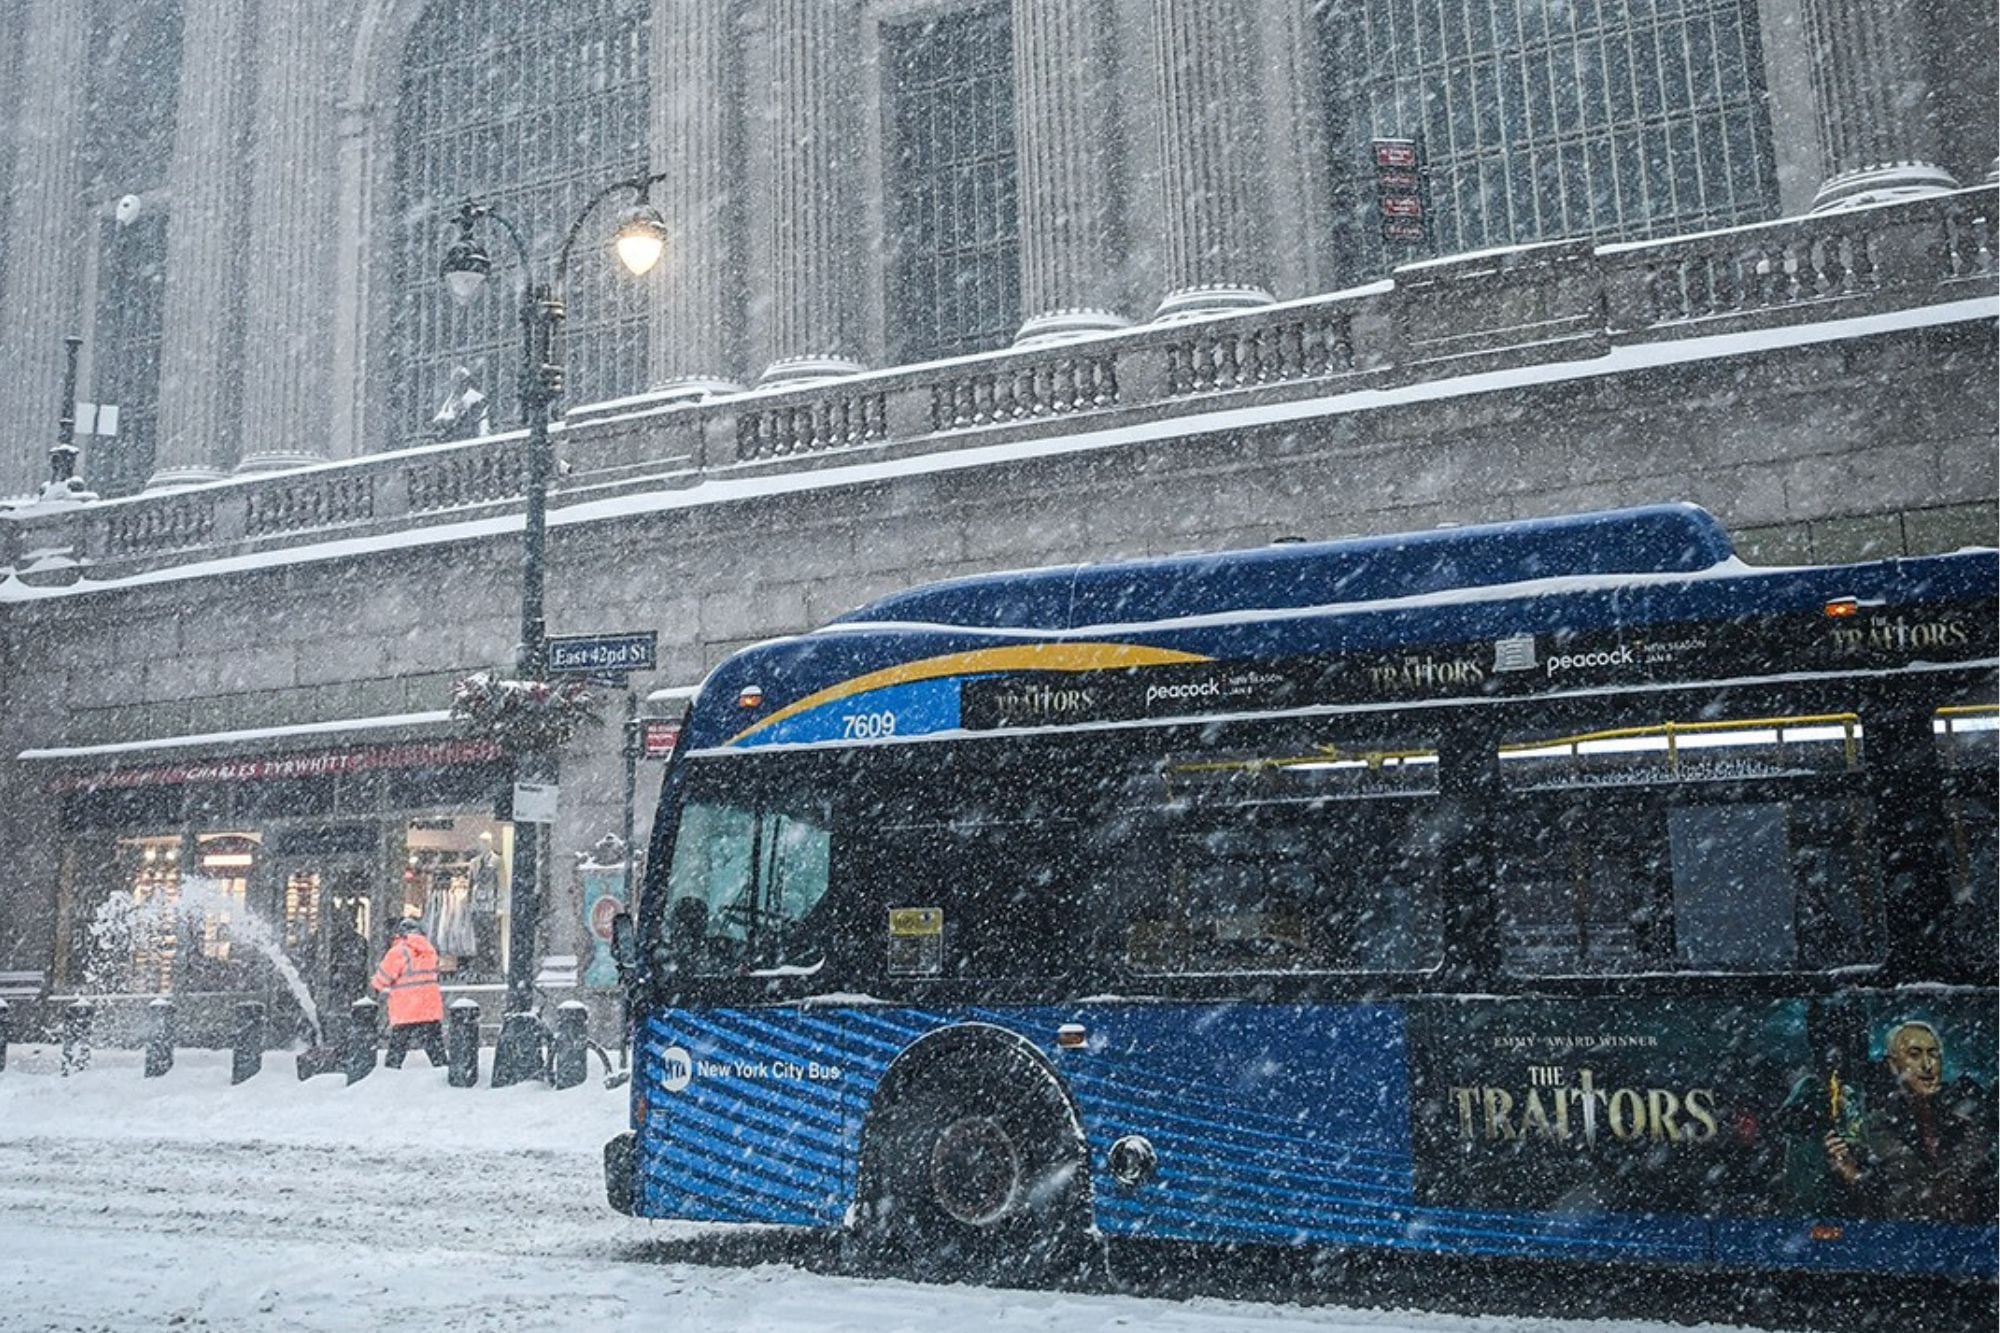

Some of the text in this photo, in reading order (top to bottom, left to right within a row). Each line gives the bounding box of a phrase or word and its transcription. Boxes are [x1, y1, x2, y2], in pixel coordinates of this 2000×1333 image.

[1829, 615, 1968, 652] TRAITORS
[555, 643, 646, 665] East 42nd St
[1547, 644, 1634, 678] peacock
[1370, 655, 1484, 689] TRAITORS
[1147, 677, 1220, 706] peacock
[842, 711, 896, 738] 7609
[186, 755, 349, 780] CHARLES TYRWHITT
[1547, 1035, 1596, 1048] AWARD
[1599, 1035, 1658, 1047] WINNER
[698, 1061, 841, 1080] New York City Bus
[1528, 1065, 1565, 1086] THE
[1449, 1069, 1718, 1150] TRAITORS
